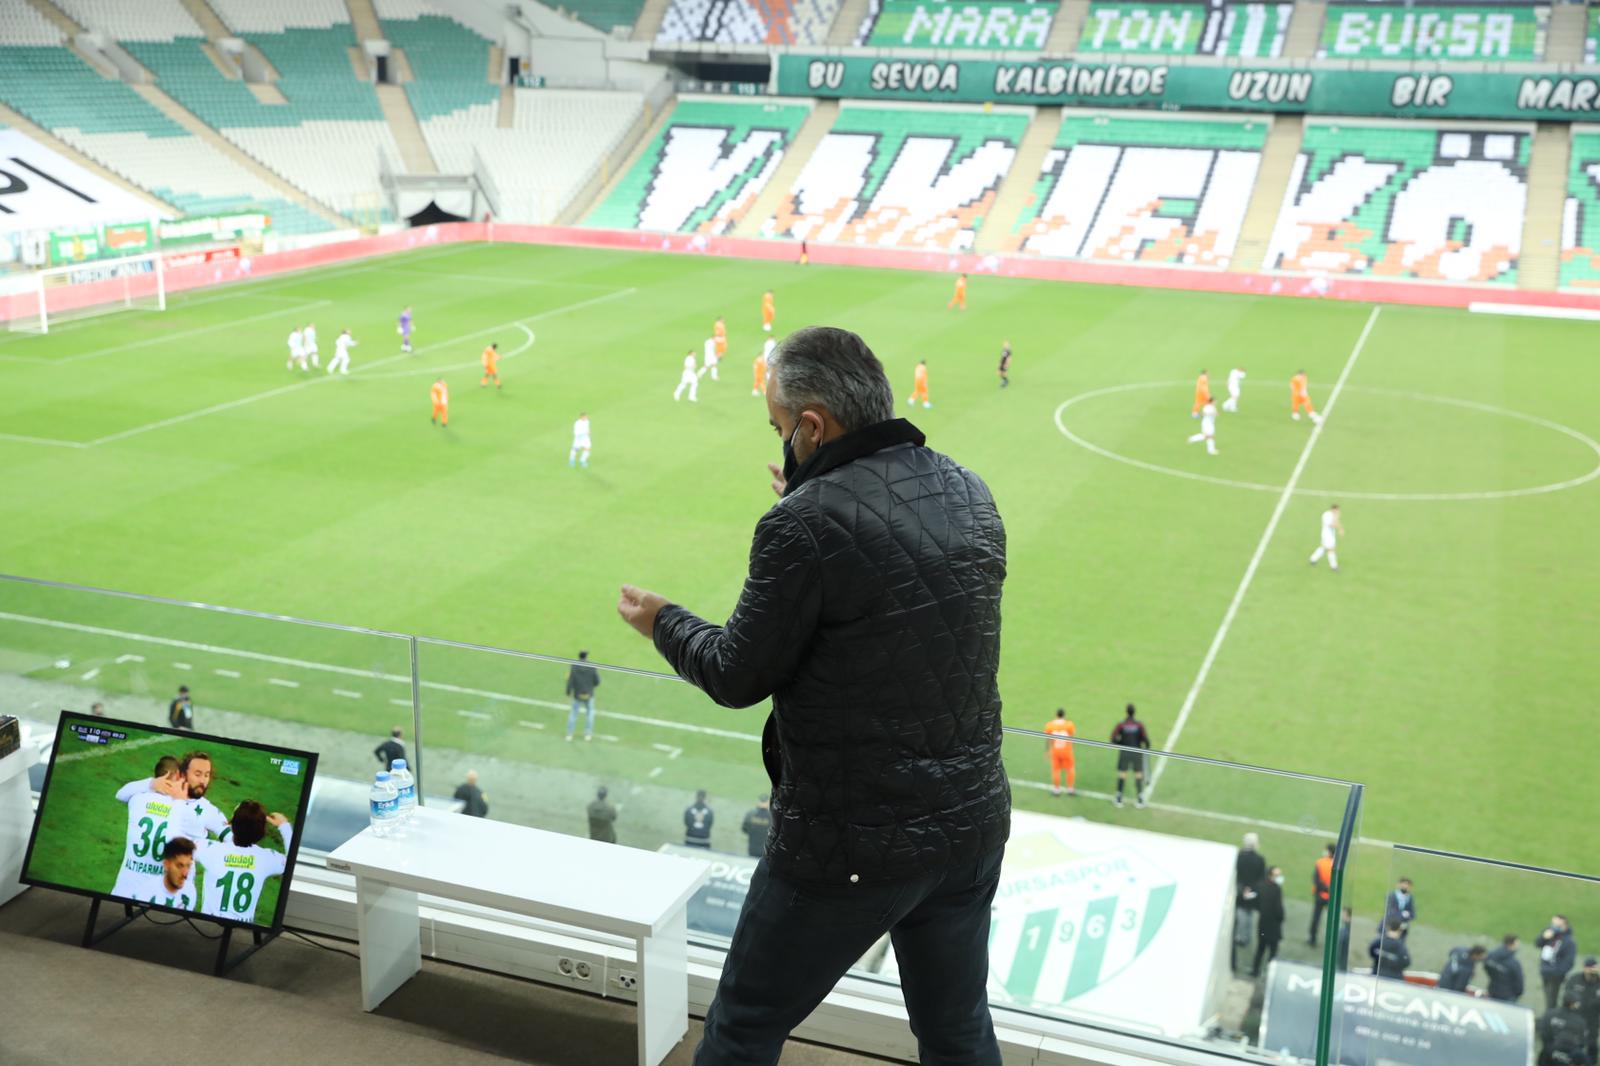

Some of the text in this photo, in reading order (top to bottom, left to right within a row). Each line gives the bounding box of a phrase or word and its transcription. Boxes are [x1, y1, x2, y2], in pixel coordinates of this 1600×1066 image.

[903, 6, 1194, 52] MARA TON
[1335, 13, 1515, 56] BURSA
[807, 61, 846, 89] BU
[871, 62, 959, 92] SEVDA
[1228, 70, 1312, 102] UZUN
[1517, 78, 1600, 111] MAR
[132, 816, 169, 862] 36
[125, 858, 164, 876] ALTIPARMA
[998, 857, 1132, 900] URSASPOR
[215, 870, 255, 913] 18
[1286, 973, 1489, 1032] MDICANA
